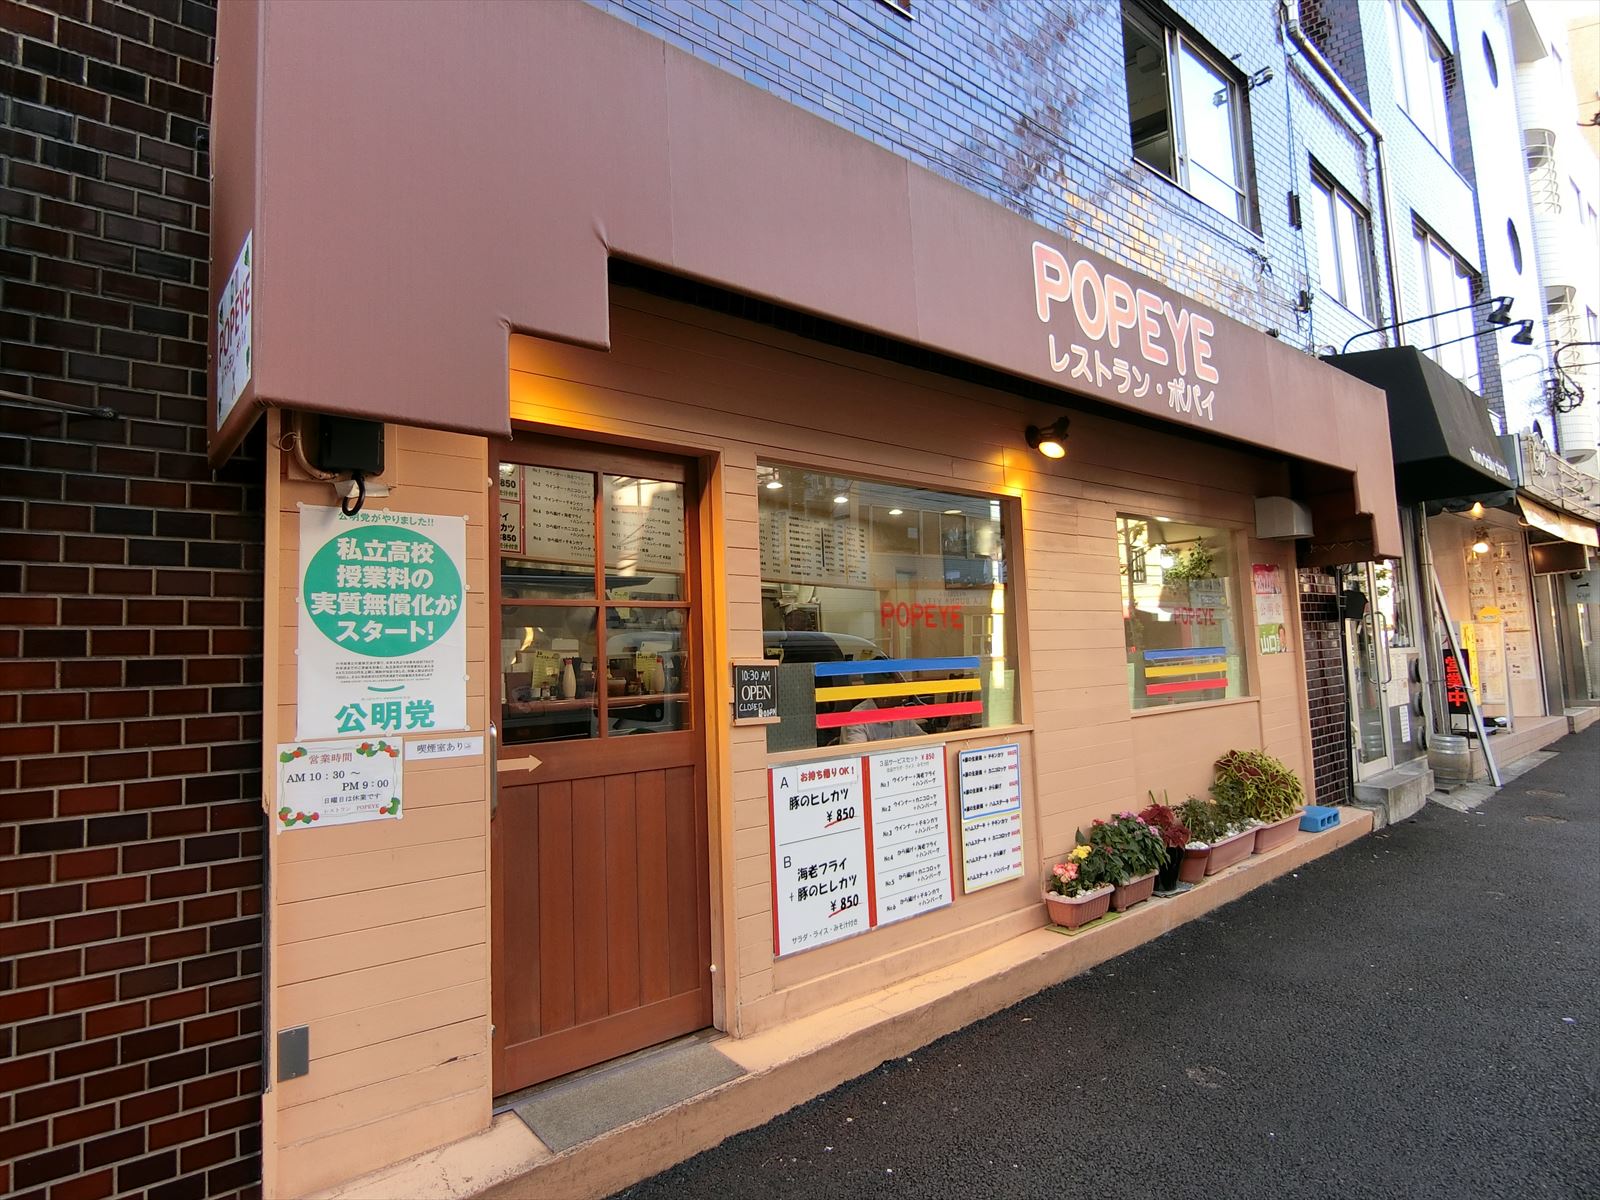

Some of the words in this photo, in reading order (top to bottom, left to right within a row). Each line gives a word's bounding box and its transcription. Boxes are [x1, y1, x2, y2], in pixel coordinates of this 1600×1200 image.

[219, 271, 250, 368] POPEYE
[1032, 241, 1219, 384] POPEYE
[1048, 334, 1215, 421] レストラン・ポパイ
[337, 537, 435, 564] 私立高校
[336, 565, 434, 590] 授業料の
[311, 591, 457, 616] 実質無償化が
[880, 601, 964, 630] POPEYE
[1174, 607, 1216, 626] POPEYE
[335, 620, 434, 642] スタート!
[741, 669, 759, 681] 10:30
[760, 670, 771, 681] AM
[741, 684, 772, 700] OPEN
[335, 699, 435, 734] 公明党
[308, 752, 353, 765] 営業時間
[416, 742, 464, 754] 喫煙室あり
[286, 773, 306, 784] AM
[342, 782, 359, 791] PM
[780, 777, 789, 789] A
[324, 793, 381, 804] 日曜日は休業です
[789, 788, 849, 811] 豚のヒレカツ
[783, 856, 792, 869] B
[797, 857, 847, 882] 海老フライ
[797, 874, 857, 902] 豚のヒレカツ
